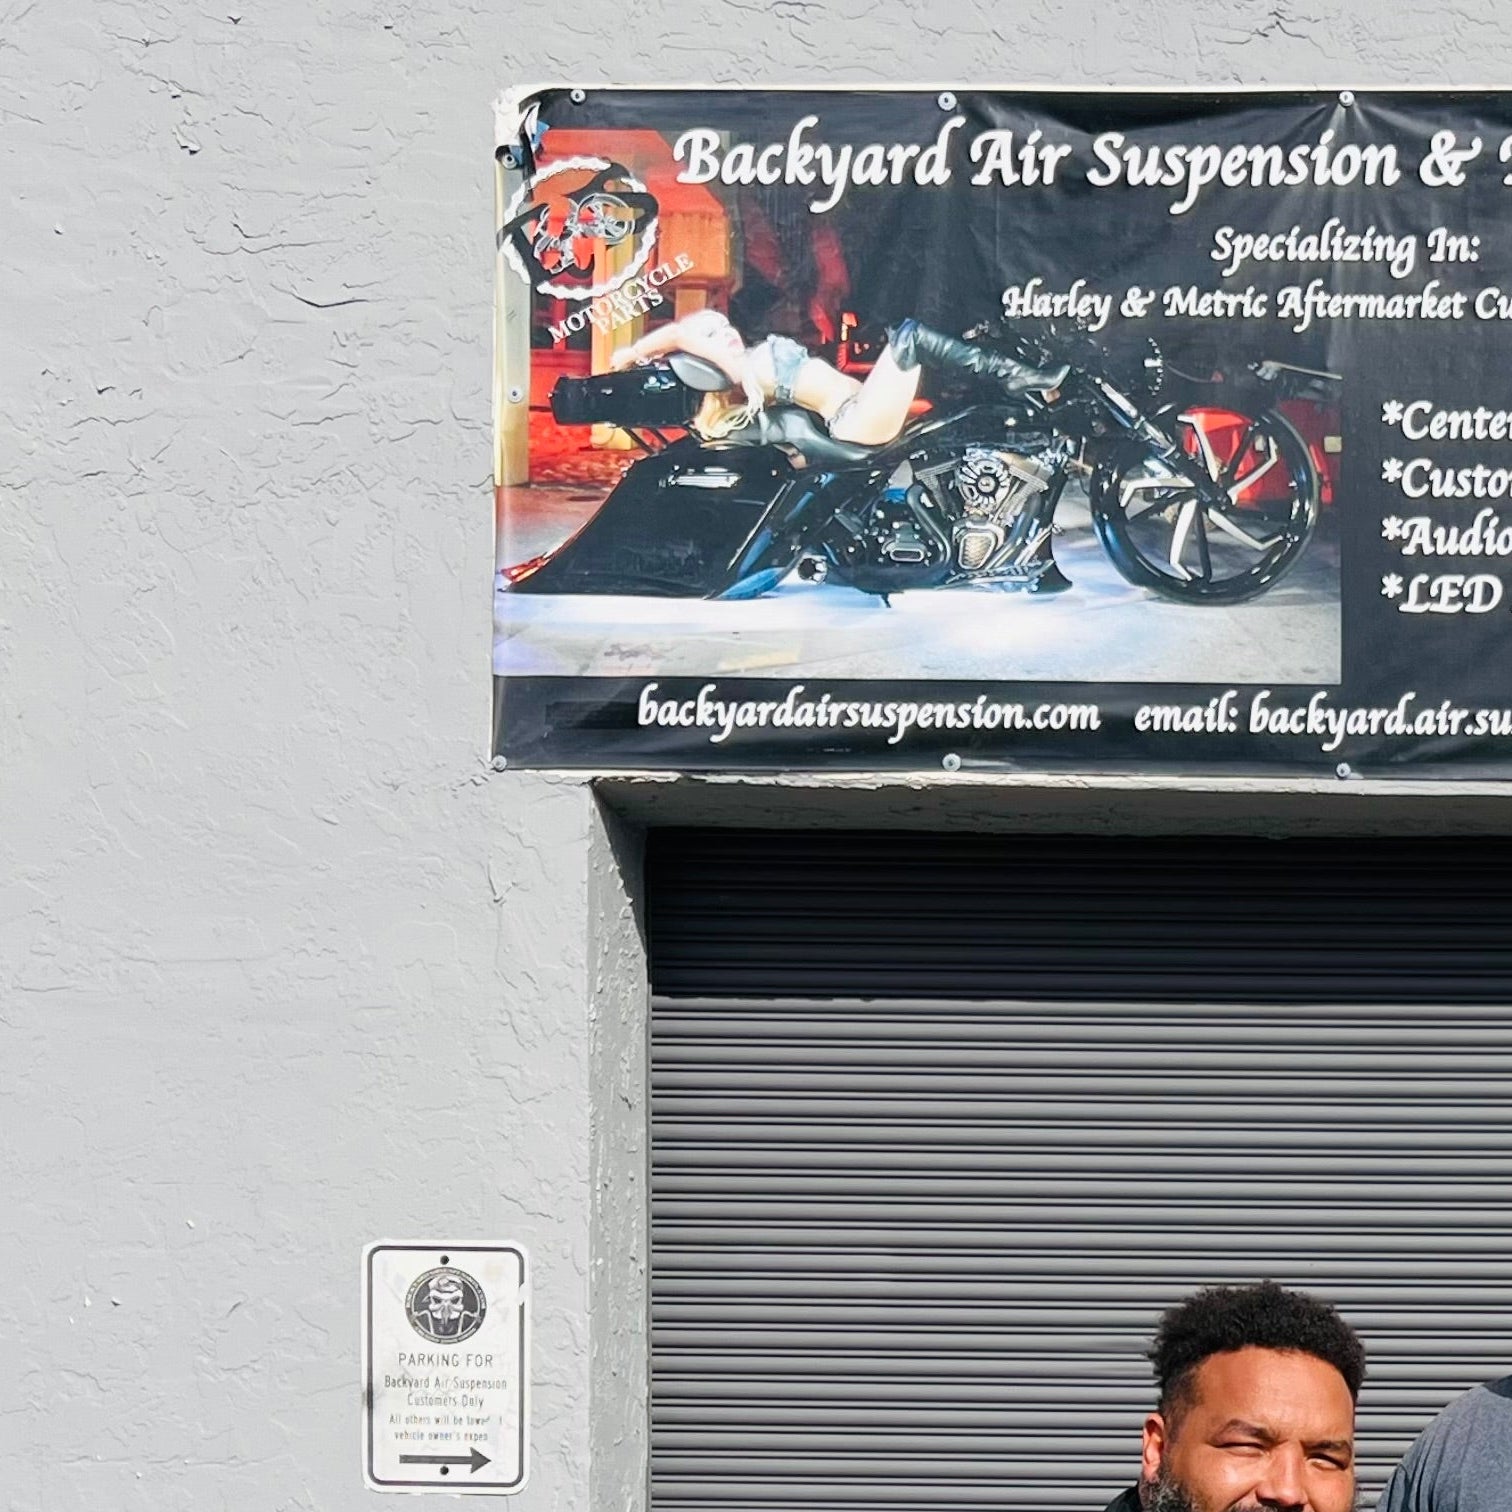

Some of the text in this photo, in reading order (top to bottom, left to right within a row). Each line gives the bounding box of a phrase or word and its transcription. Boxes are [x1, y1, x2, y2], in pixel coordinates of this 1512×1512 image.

[672, 115, 966, 213] Backyard
[970, 128, 1073, 186] Air
[1086, 129, 1401, 214] Suspension
[1419, 129, 1483, 187] &
[1210, 217, 1481, 277] Specializing In:
[548, 253, 694, 344] MOTORCYCLE
[597, 287, 663, 336] PARTS
[1001, 278, 1112, 332] Harley
[1120, 286, 1156, 318] &
[1162, 285, 1269, 318] Metric
[1276, 279, 1468, 331] Aftermarket
[638, 683, 1101, 744] backyardairsuspension.com
[1134, 689, 1239, 733] email:
[384, 1375, 430, 1390] Backyard
[453, 1376, 507, 1392] Suspension
[398, 1353, 494, 1368] PARKING FOR
[407, 1393, 457, 1407] Customers
